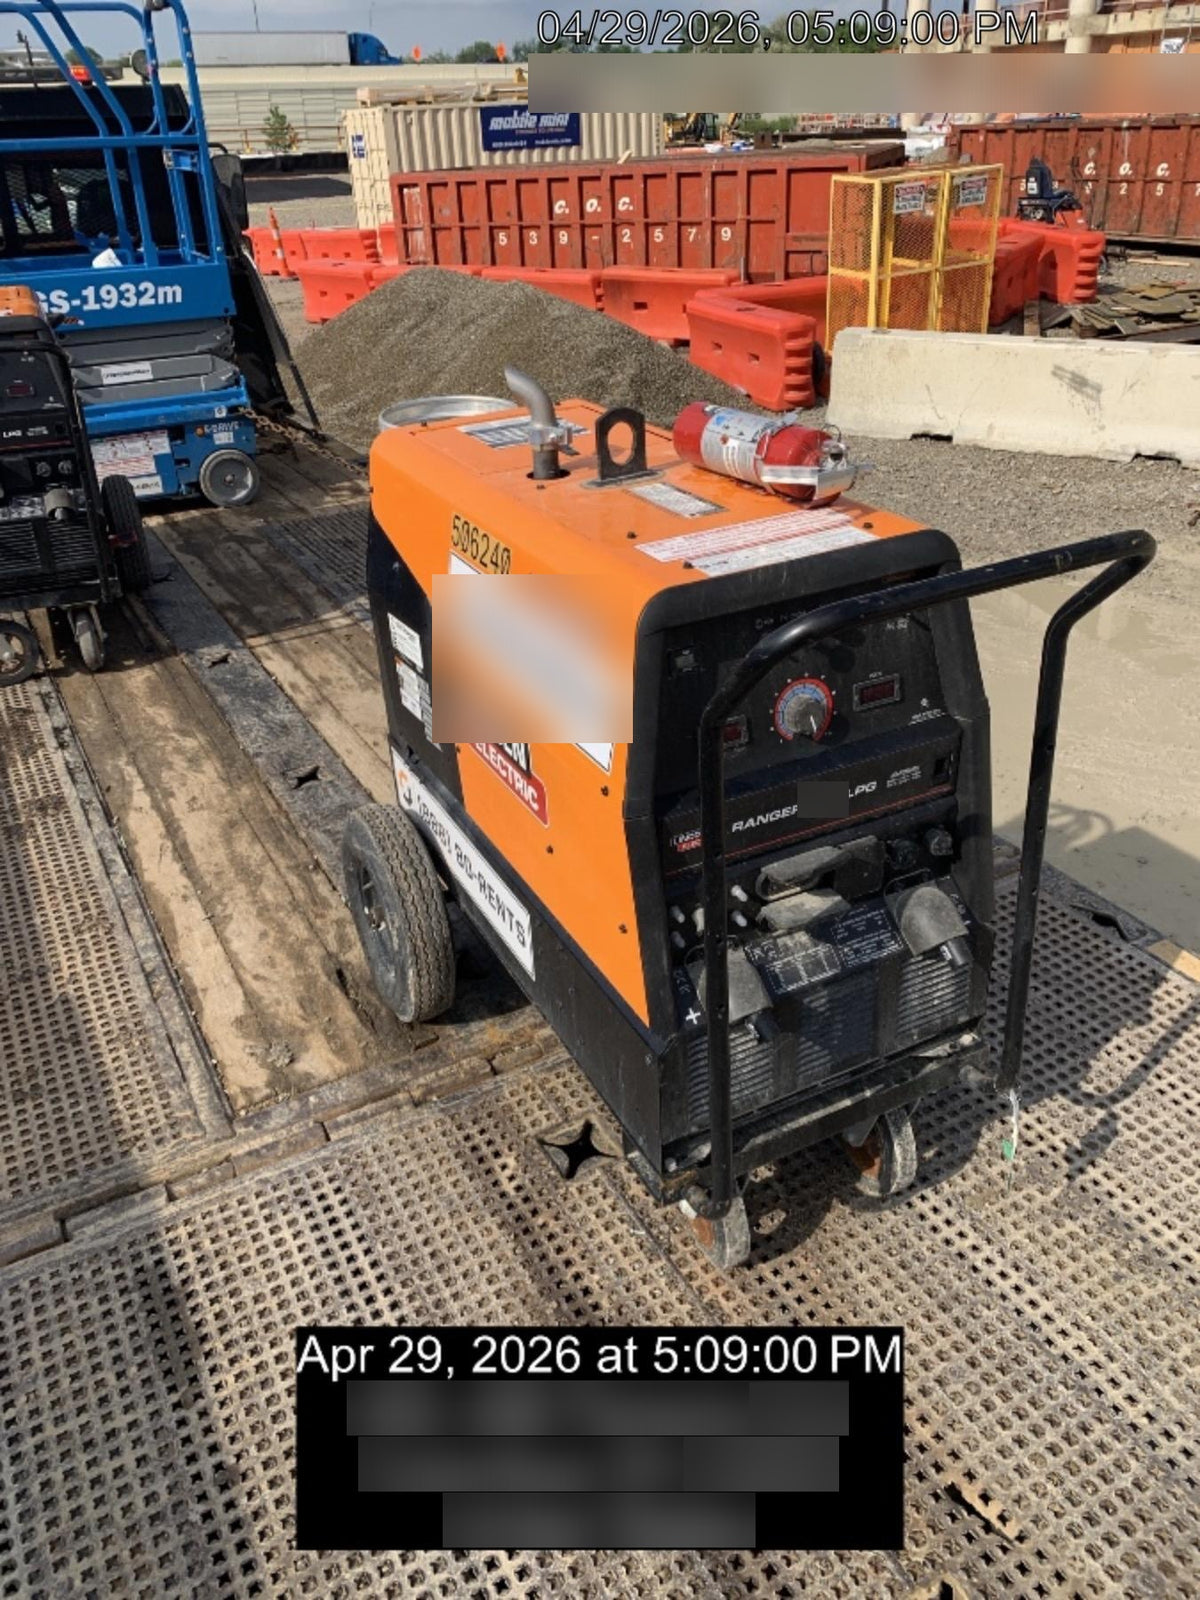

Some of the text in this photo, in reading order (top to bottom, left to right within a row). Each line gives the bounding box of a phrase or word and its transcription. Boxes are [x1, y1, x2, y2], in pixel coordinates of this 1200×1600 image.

[451, 514, 512, 575] 506240
[475, 743, 540, 812] ELECTRIC
[848, 780, 878, 799] LPG
[454, 842, 526, 948] 80-RENTS
